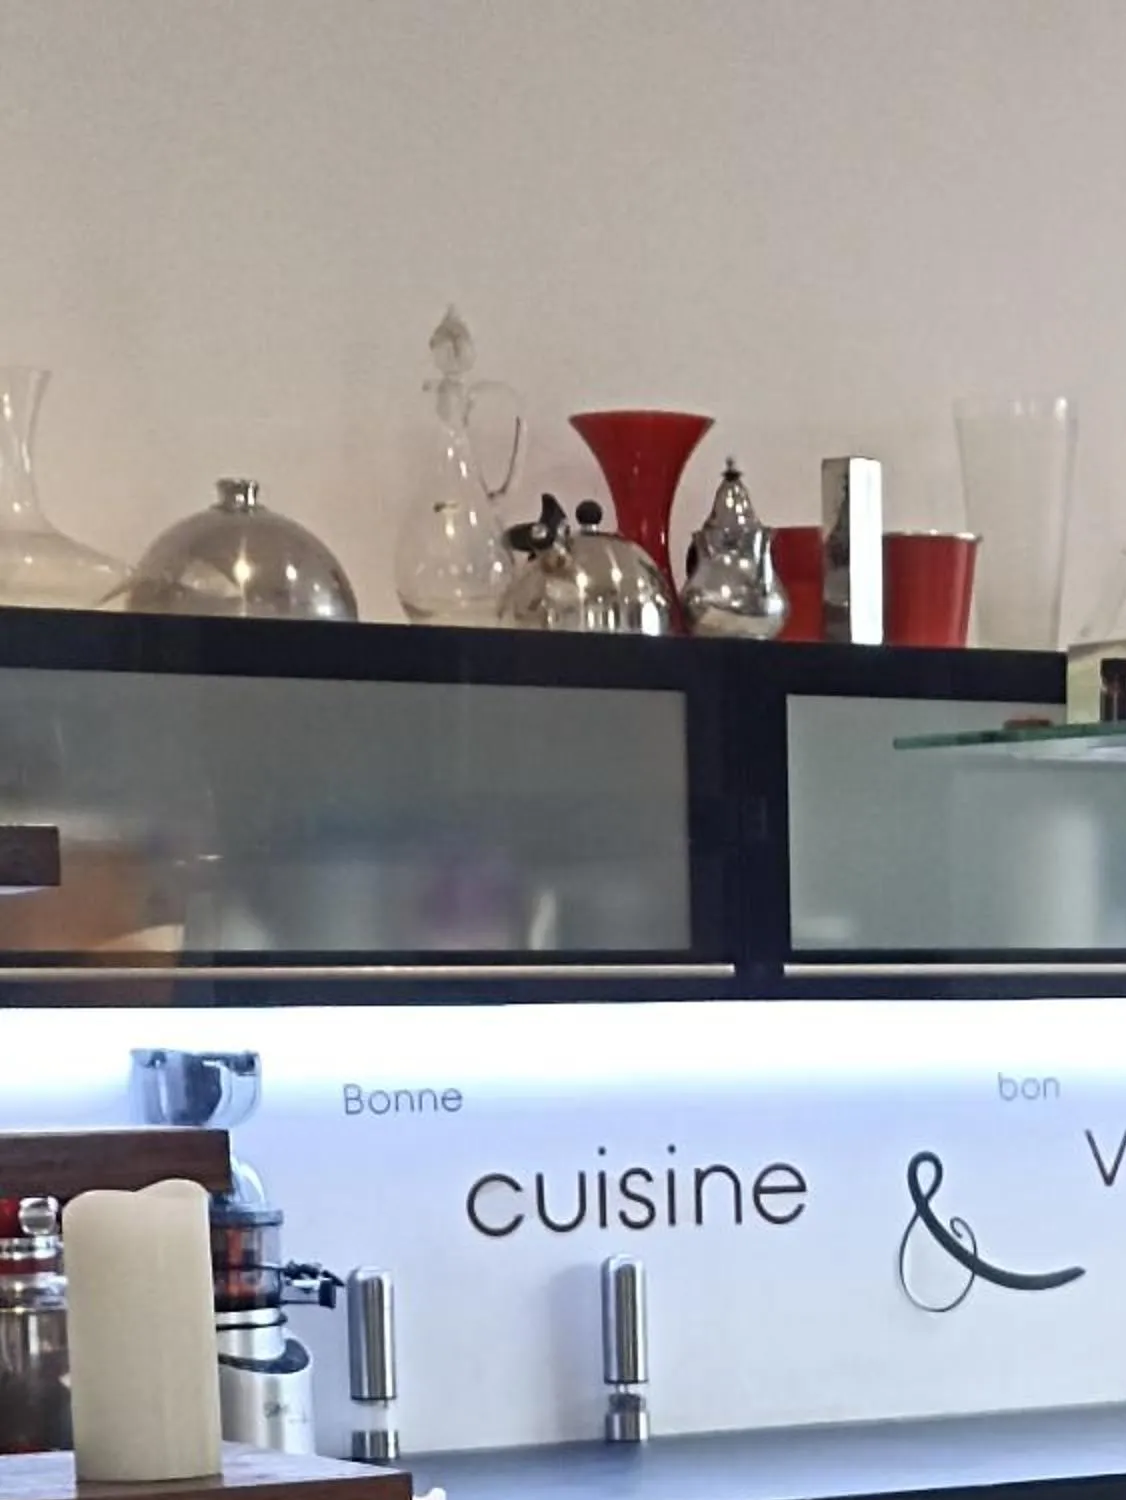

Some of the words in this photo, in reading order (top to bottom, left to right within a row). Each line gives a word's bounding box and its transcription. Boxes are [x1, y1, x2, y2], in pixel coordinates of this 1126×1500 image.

[342, 1083, 463, 1116] Bonne
[997, 1072, 1060, 1102] bon
[465, 1144, 808, 1239] cuisine
[898, 1149, 1086, 1313] &
